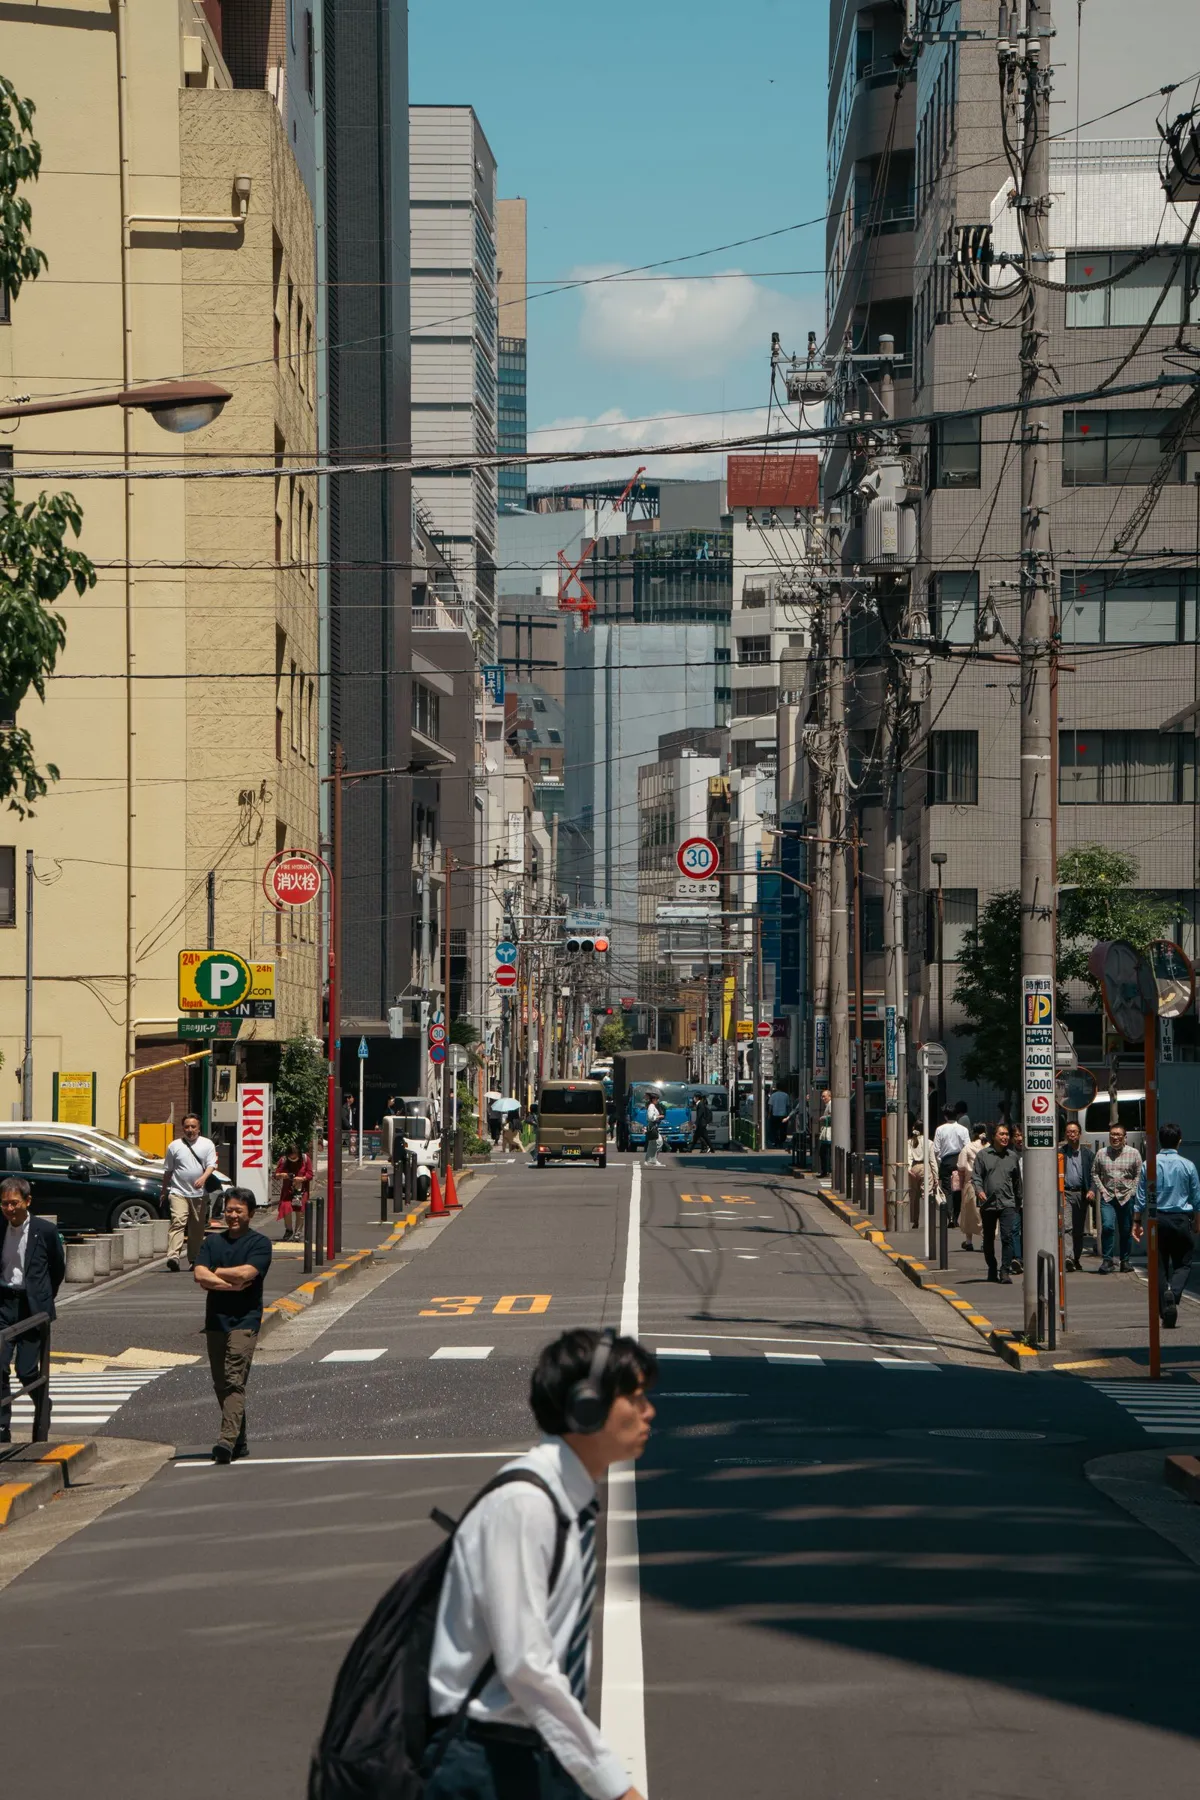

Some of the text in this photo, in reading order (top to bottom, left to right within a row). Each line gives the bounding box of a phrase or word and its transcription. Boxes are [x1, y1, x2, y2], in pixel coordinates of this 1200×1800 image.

[687, 849, 709, 867] 30
[277, 872, 316, 890] 消火栓
[678, 884, 717, 893] ここまで
[182, 953, 200, 966] 24h
[256, 965, 272, 973] 24h
[211, 963, 239, 1000] P
[182, 997, 203, 1009] Repark
[433, 1030, 444, 1038] 30
[1026, 1054, 1052, 1065] 4000
[1026, 1079, 1052, 1090] 2000
[242, 1089, 264, 1168] KIRIN
[418, 1294, 552, 1316] 30
